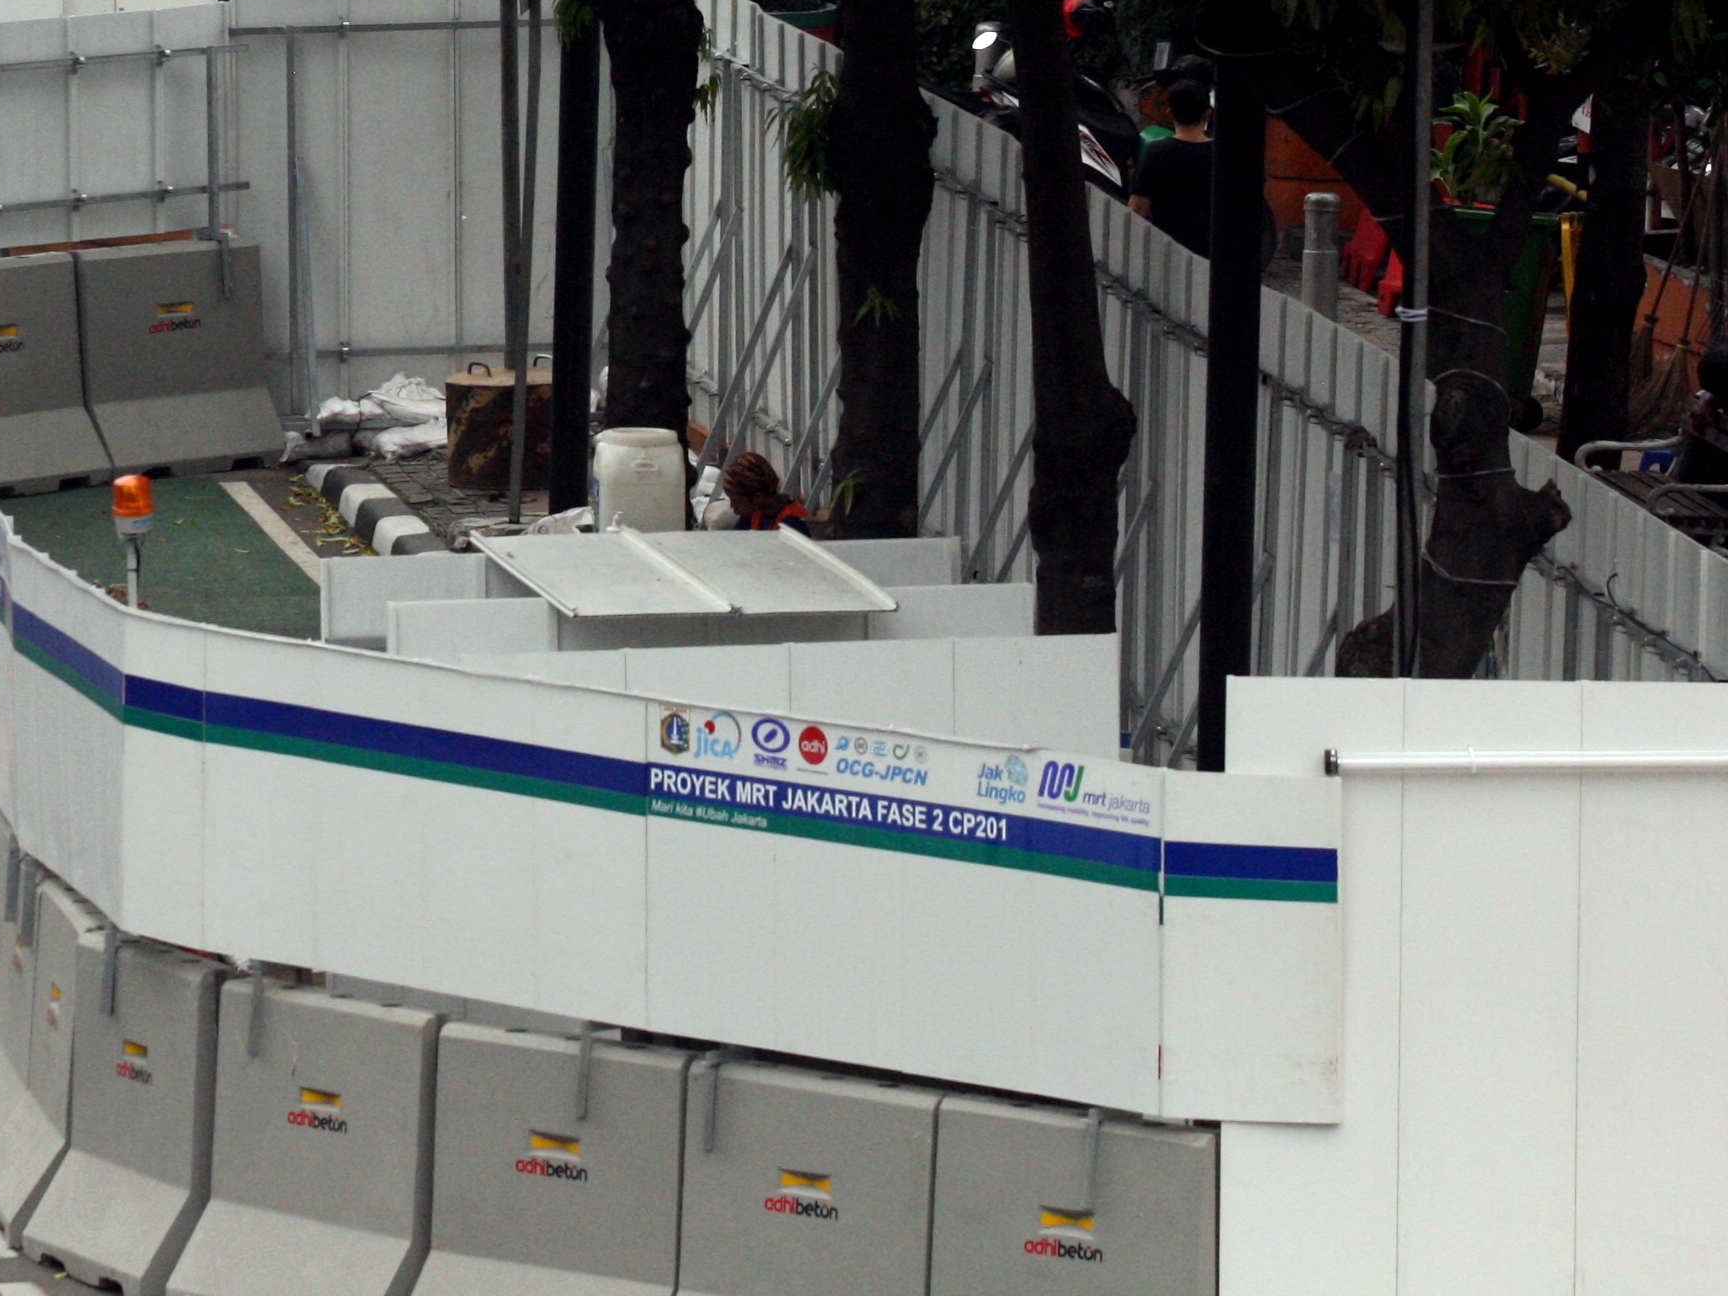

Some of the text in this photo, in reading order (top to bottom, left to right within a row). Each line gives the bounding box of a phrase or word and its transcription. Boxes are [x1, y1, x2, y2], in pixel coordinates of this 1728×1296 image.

[801, 738, 826, 754] adhi
[836, 757, 929, 787] OCG-JPCN
[977, 762, 1003, 781] Jak
[650, 767, 731, 802] PROYEK
[735, 781, 778, 806] MRT
[782, 789, 872, 822] JAKARTA
[877, 803, 927, 830] FASE
[932, 812, 943, 832] 2
[949, 811, 1007, 842] CP201
[976, 781, 1026, 805] Lingko
[1083, 790, 1151, 815] mrt jakarta
[651, 799, 673, 814] Mari
[675, 804, 693, 818] kita
[730, 811, 768, 829] Jakarta
[288, 1109, 348, 1135] adhibeton
[515, 1157, 589, 1183] adhibeton
[764, 1195, 839, 1222] adhibeton
[1024, 1237, 1103, 1263] adhibeton
